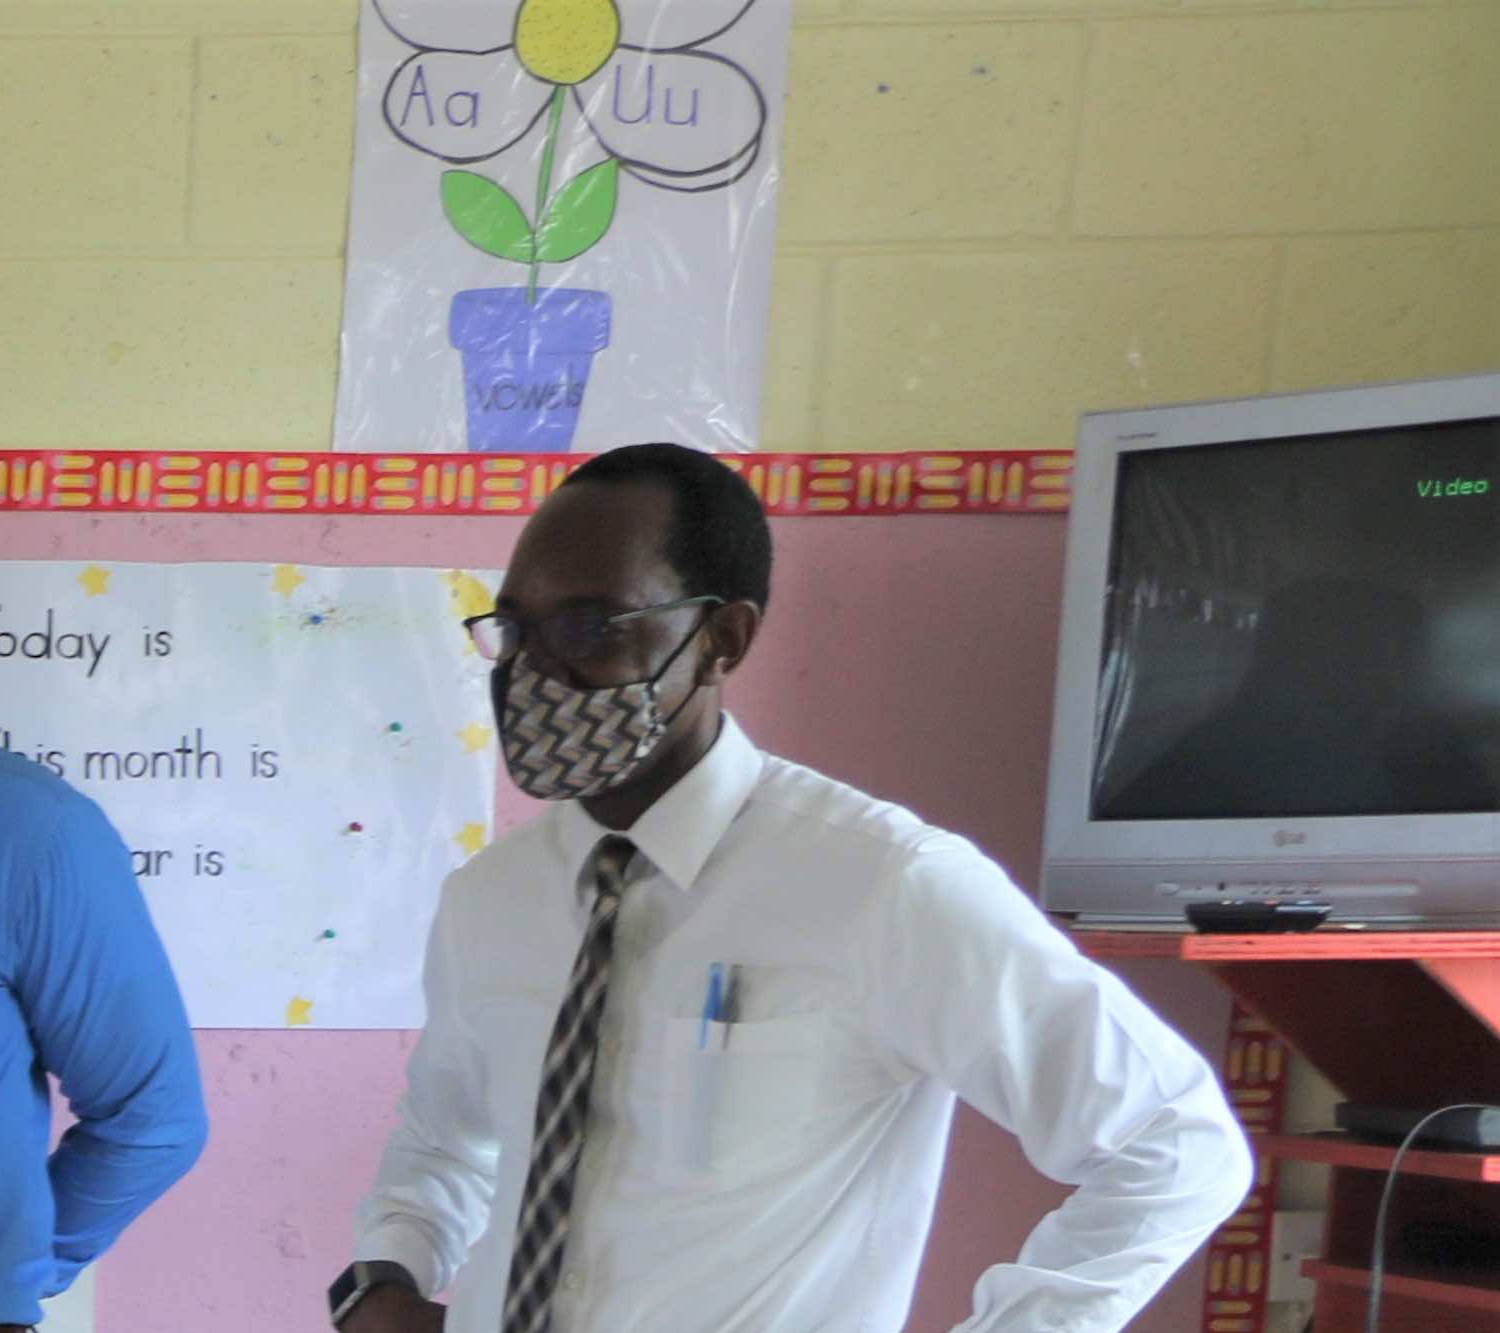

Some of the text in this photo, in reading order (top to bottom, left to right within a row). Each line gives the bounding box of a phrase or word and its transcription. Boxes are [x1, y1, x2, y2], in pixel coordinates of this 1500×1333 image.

[1417, 478, 1490, 497] Video
[143, 624, 173, 657] is
[84, 727, 222, 780] month
[251, 744, 280, 779] is
[194, 844, 225, 878] is
